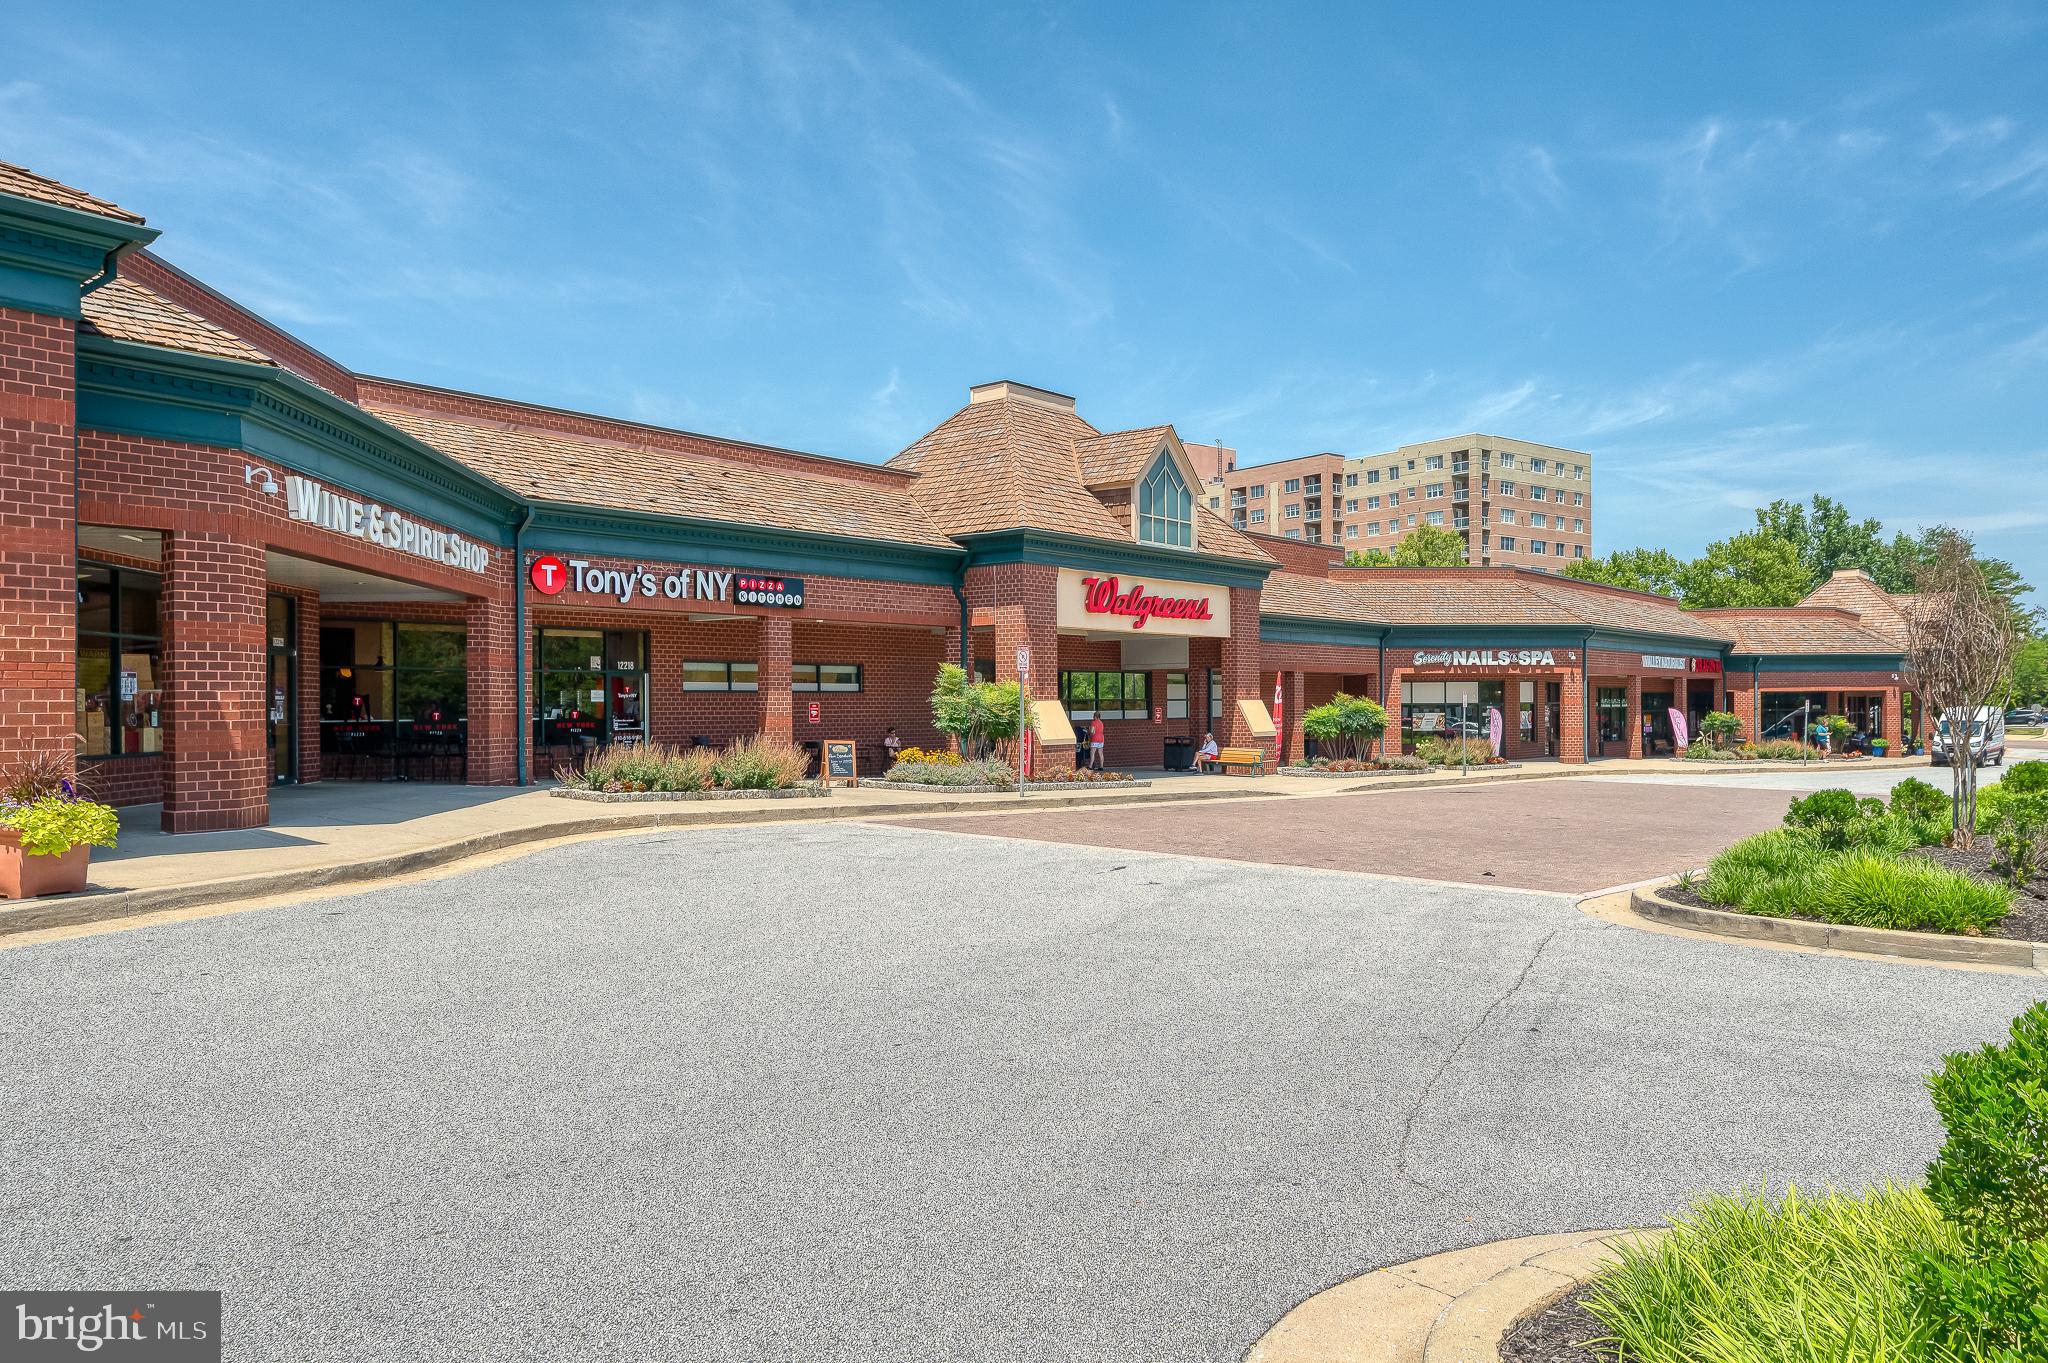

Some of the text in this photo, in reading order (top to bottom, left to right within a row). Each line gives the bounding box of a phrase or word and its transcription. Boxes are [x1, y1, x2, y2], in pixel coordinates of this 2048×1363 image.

[285, 476, 489, 574] WINE & SPIRIT SHOP
[541, 564, 558, 587] T
[568, 559, 732, 604] Tony's of NY
[739, 579, 784, 592] PIZZA
[739, 591, 802, 605] KITCHEN
[1082, 576, 1213, 629] Walgreens
[1413, 651, 1453, 667] Serenity
[1453, 650, 1511, 666] NAILS
[1518, 650, 1555, 666] SPA
